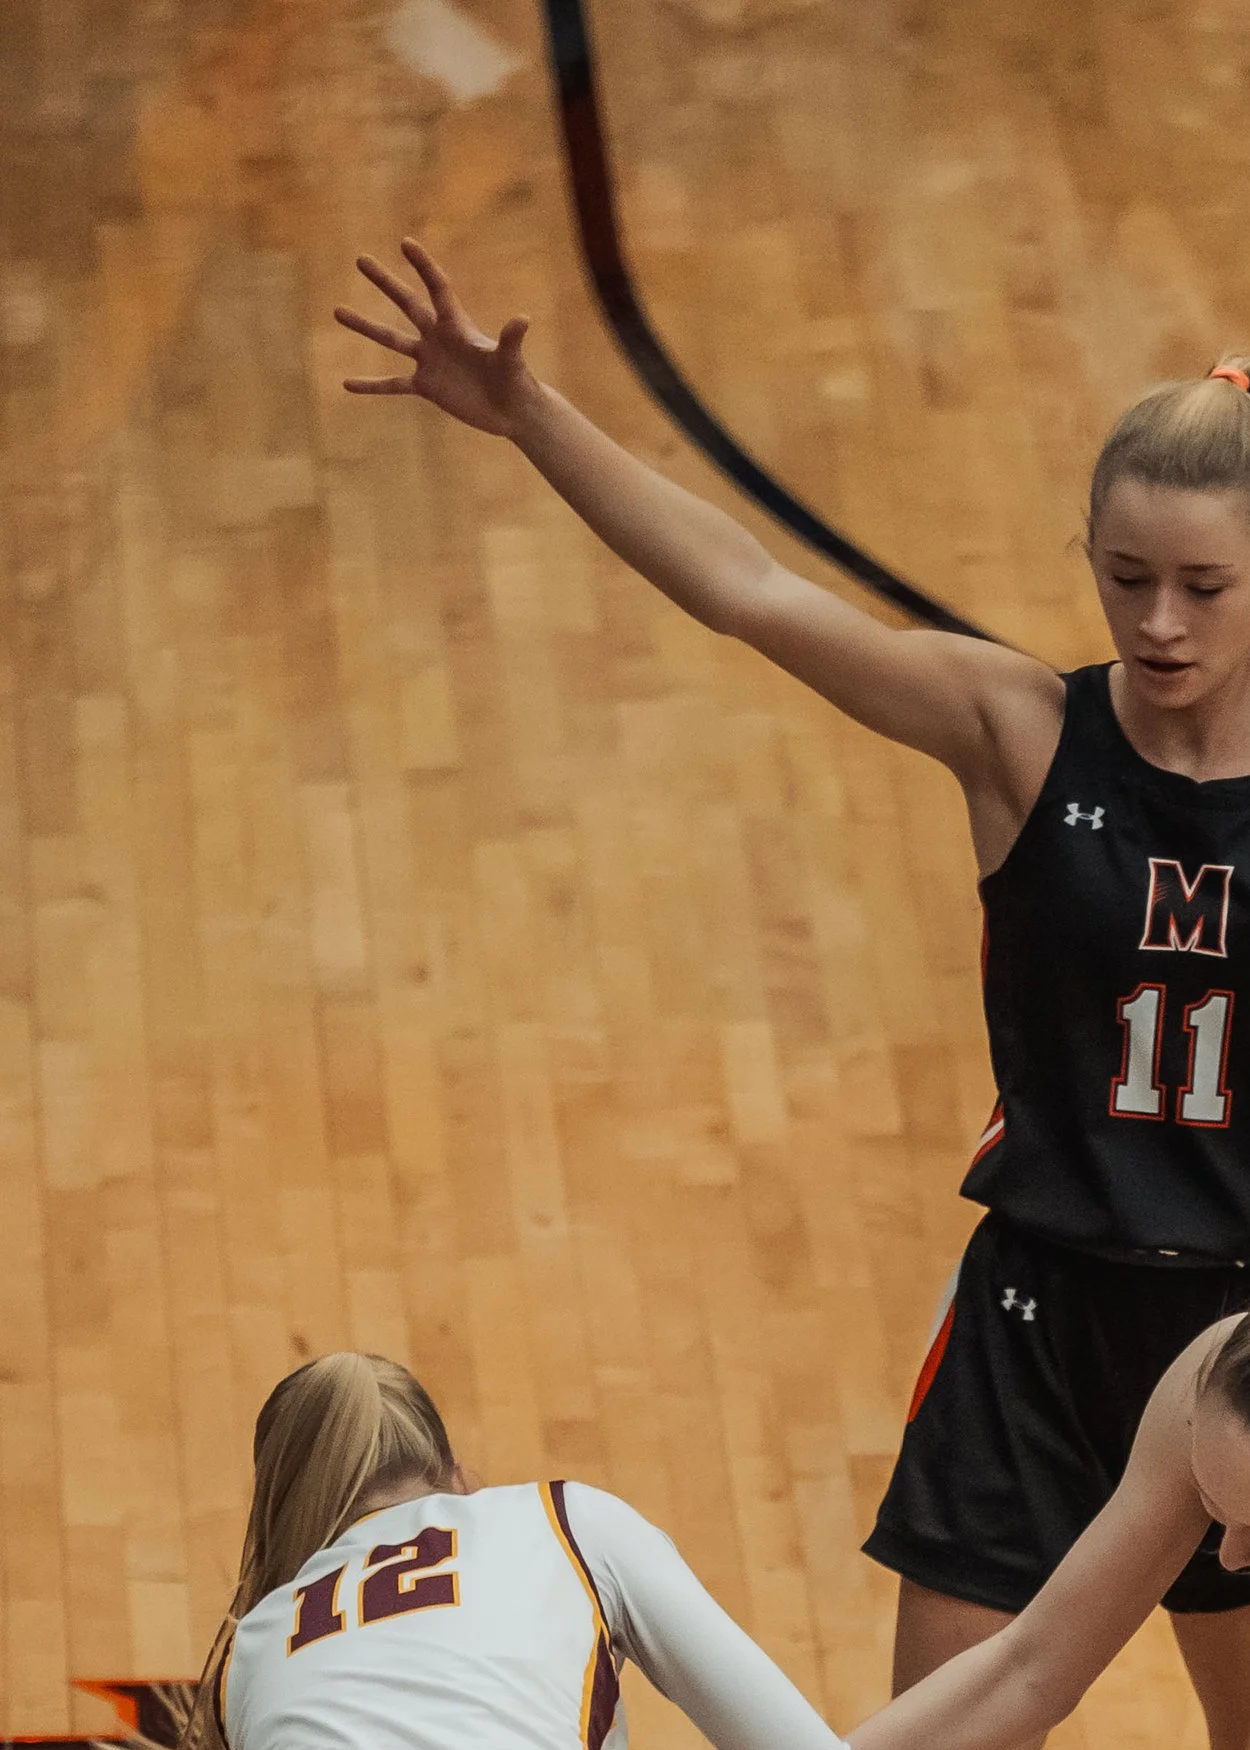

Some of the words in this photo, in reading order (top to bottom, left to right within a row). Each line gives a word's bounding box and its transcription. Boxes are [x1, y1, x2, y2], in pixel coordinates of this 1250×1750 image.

[1139, 857, 1235, 958] M
[1108, 982, 1235, 1129] 11
[286, 1526, 461, 1659] 12
